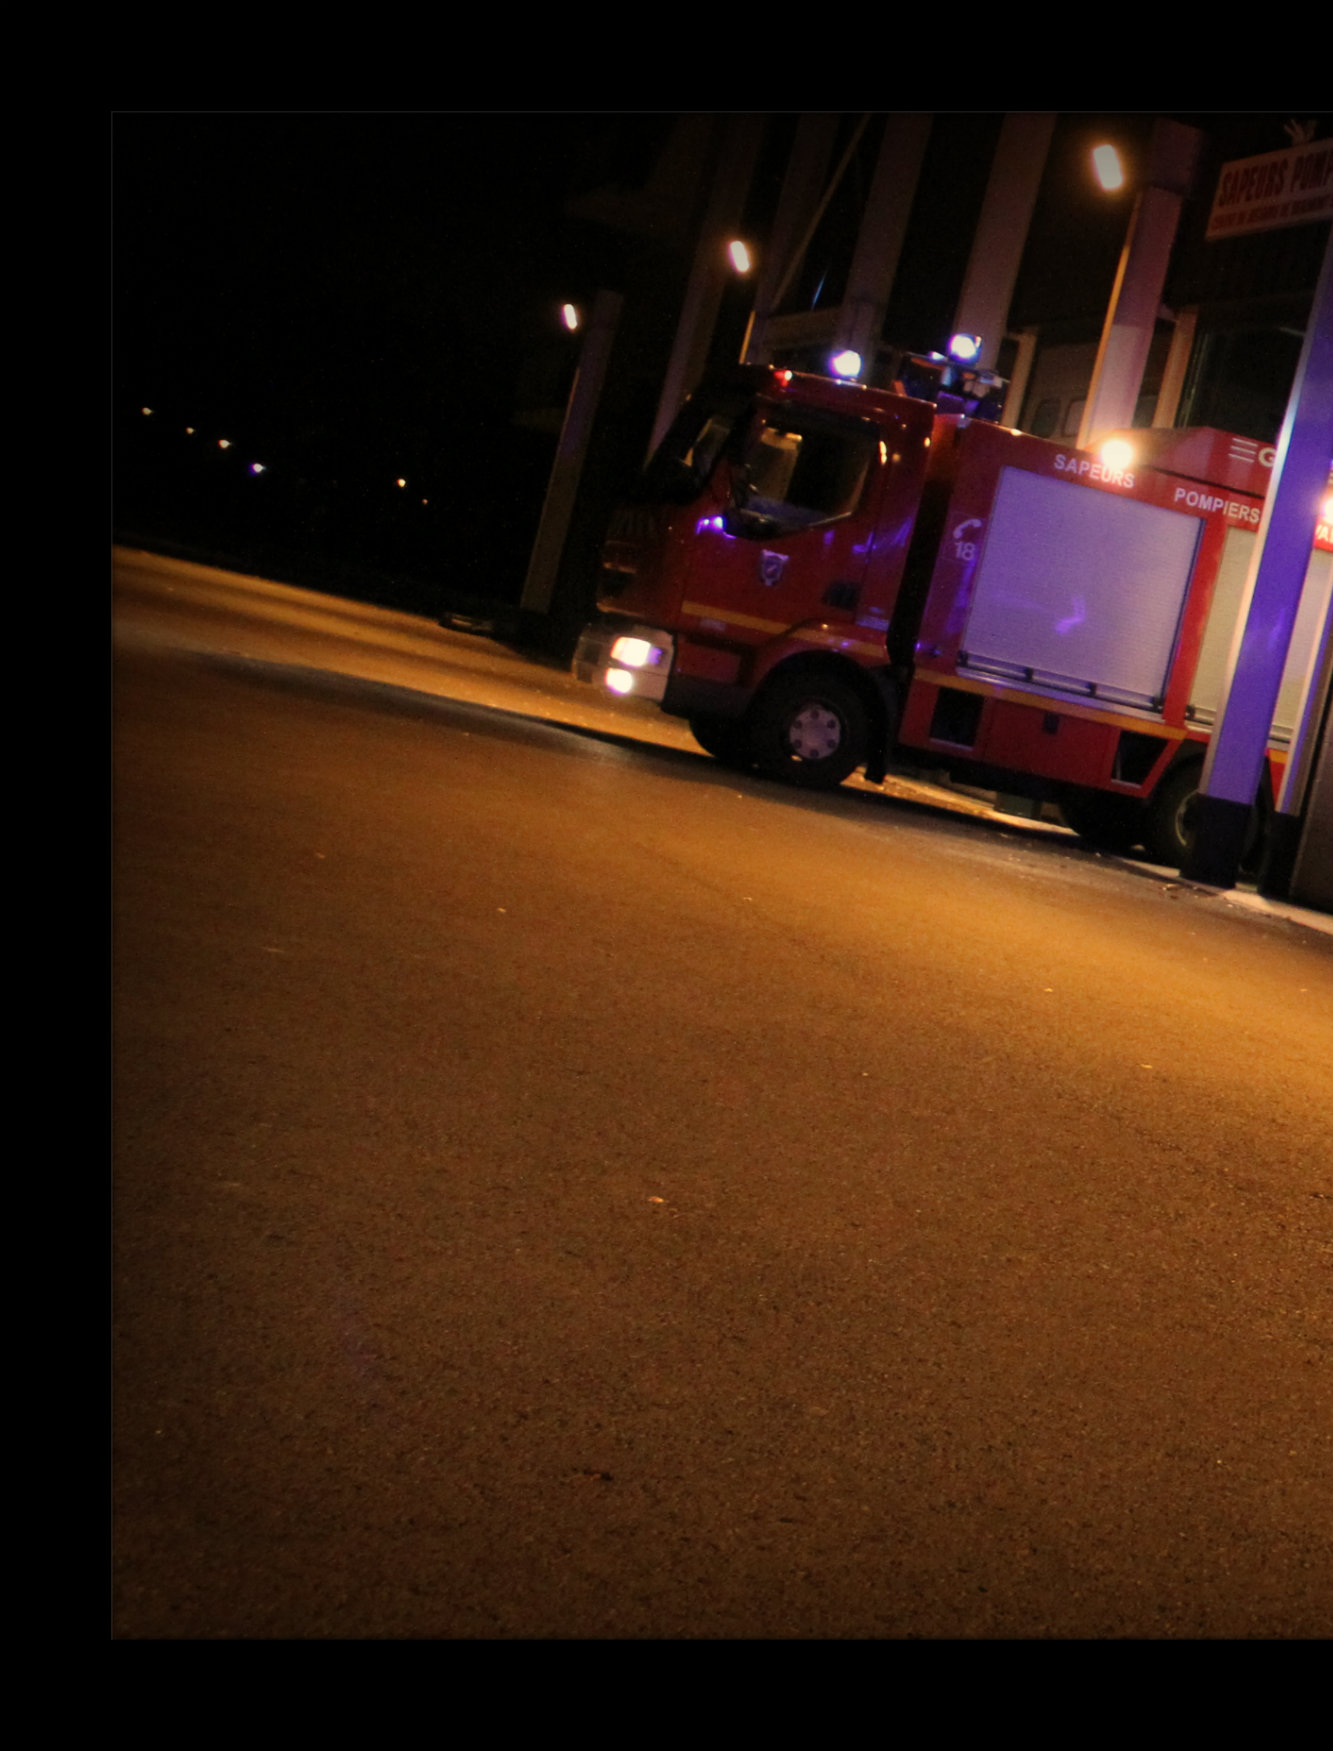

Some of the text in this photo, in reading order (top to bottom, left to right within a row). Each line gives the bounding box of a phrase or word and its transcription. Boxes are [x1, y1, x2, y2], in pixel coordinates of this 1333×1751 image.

[1218, 158, 1289, 207] SAPEURS
[1053, 453, 1136, 489] SAPEURS
[1174, 486, 1261, 525] POMPIERS
[954, 541, 975, 562] 18
